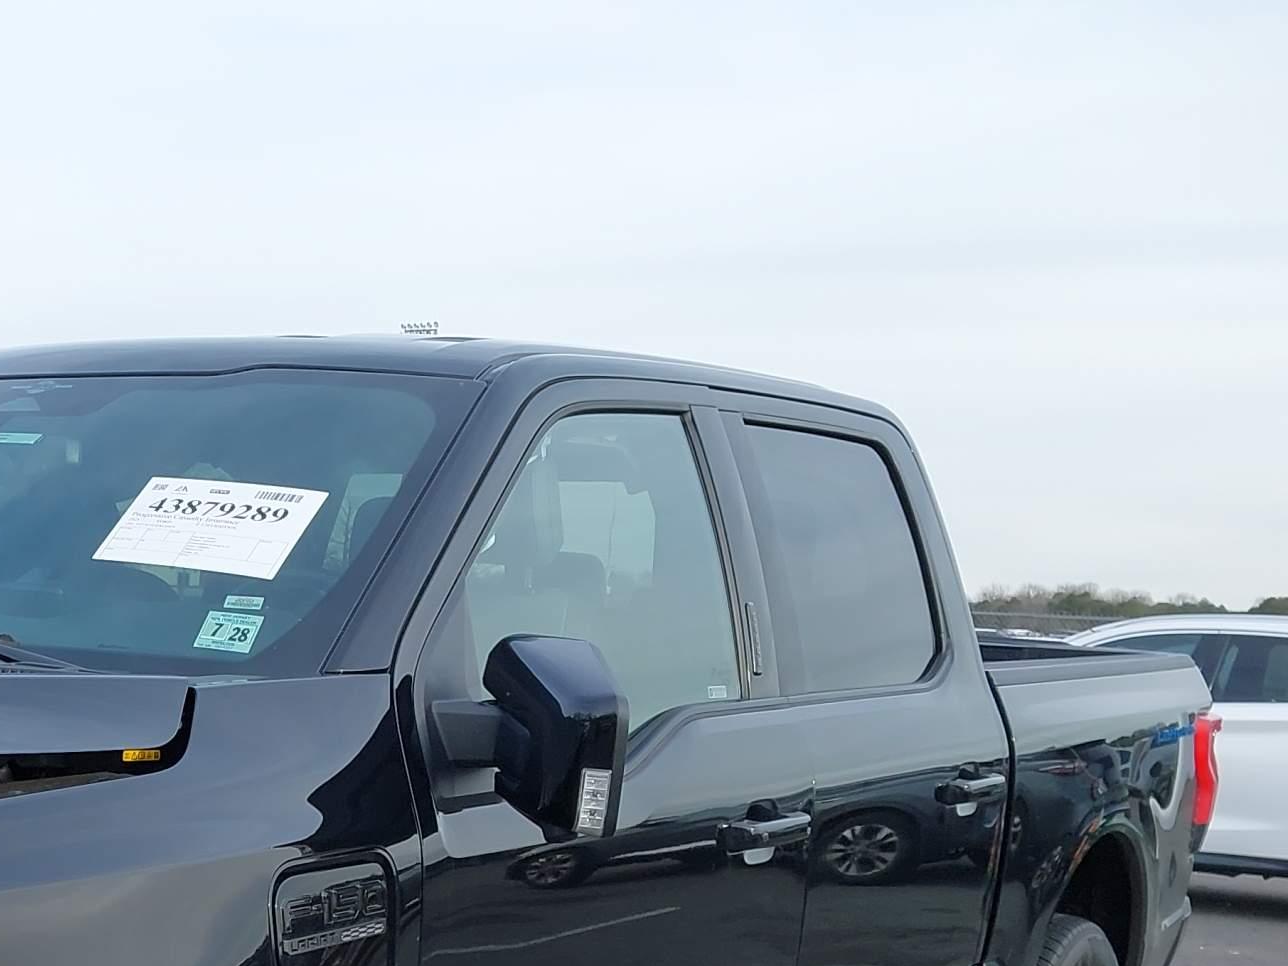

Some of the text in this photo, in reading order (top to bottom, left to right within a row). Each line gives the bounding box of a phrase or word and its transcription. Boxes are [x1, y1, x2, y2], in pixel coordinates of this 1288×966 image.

[148, 497, 289, 524] 43879289
[211, 622, 250, 642] 7 28
[289, 932, 337, 953] LARIAT
